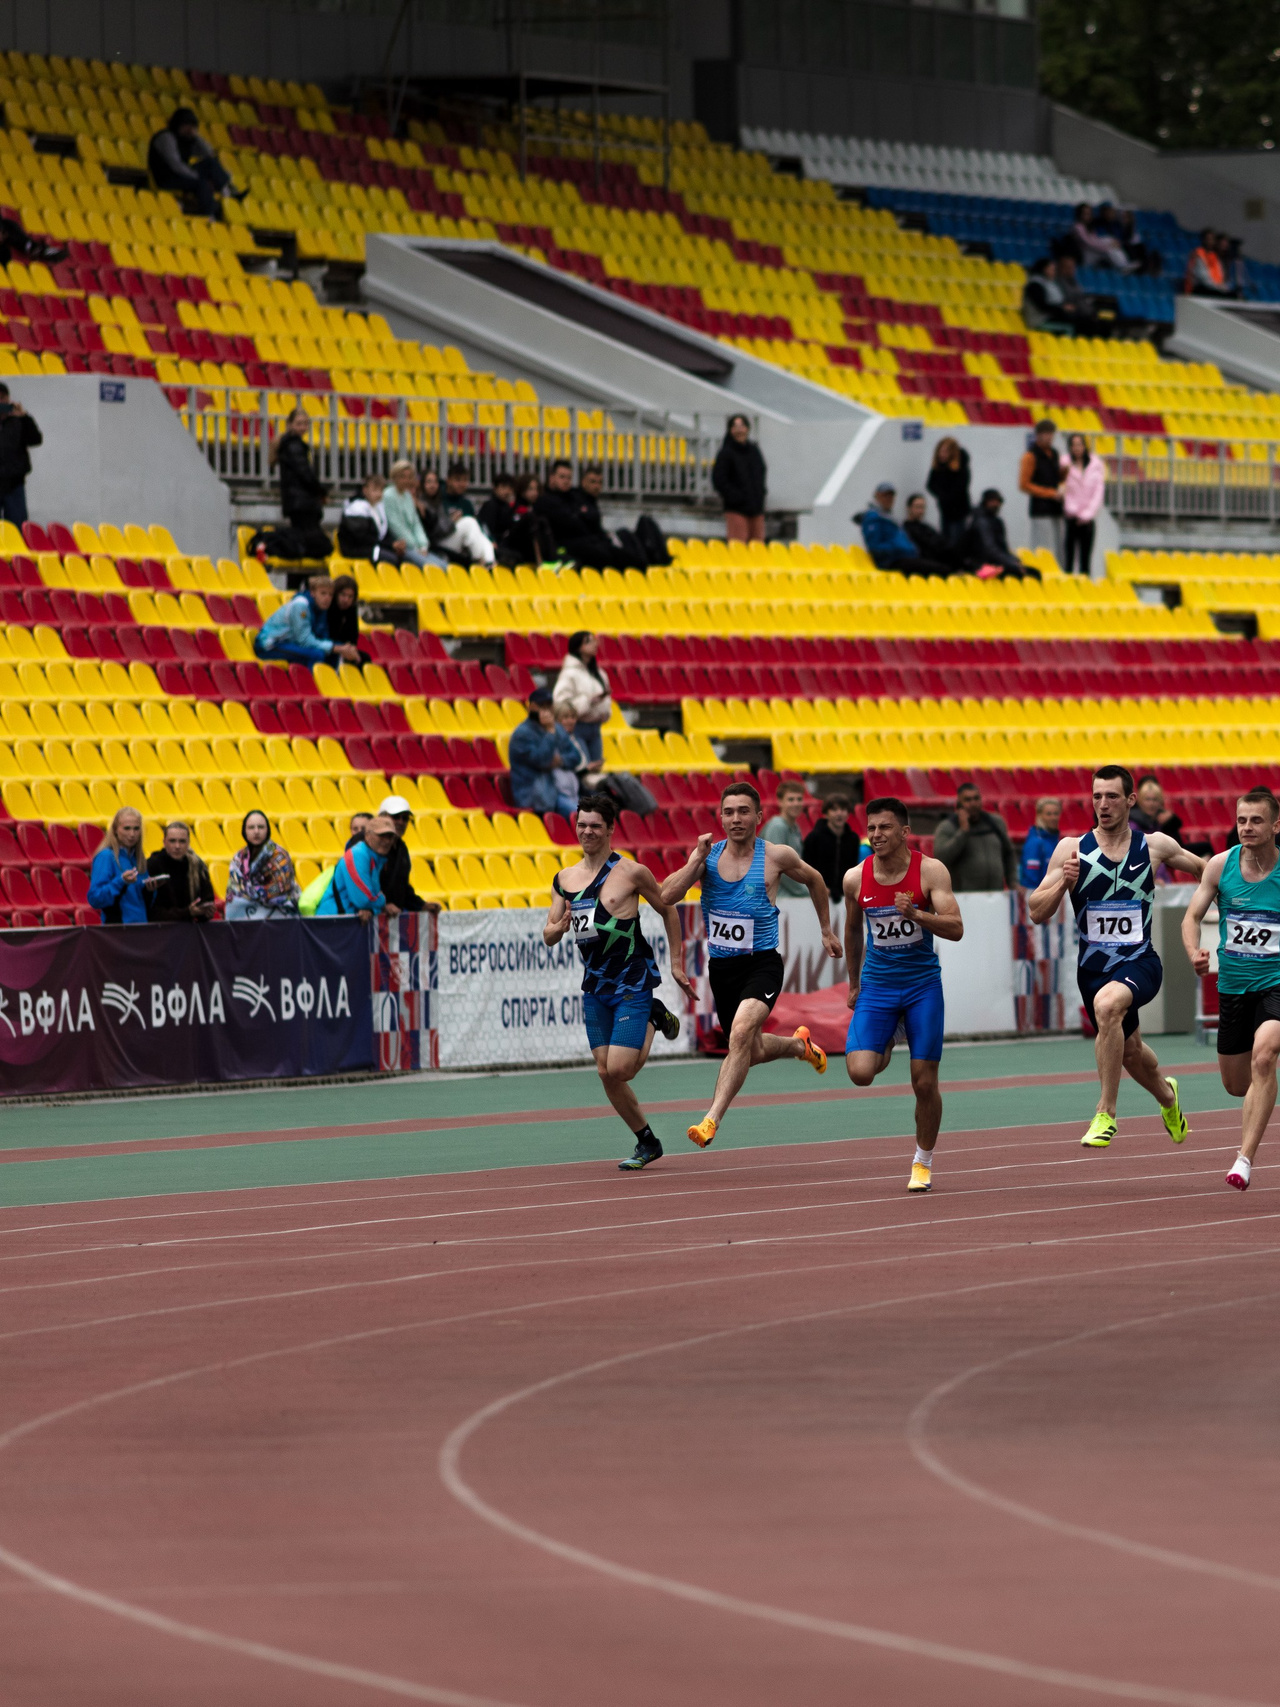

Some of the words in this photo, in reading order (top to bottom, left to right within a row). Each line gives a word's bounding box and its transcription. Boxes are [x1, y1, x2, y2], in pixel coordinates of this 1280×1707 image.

[571, 914, 589, 933] 92
[712, 920, 745, 941] 740
[875, 919, 915, 939] 240
[1096, 916, 1132, 935] 170
[1232, 925, 1272, 946] 249
[450, 933, 575, 975] ВСЕРОССИЙСКАЯ
[151, 981, 226, 1028] ВФЛА
[280, 975, 351, 1020] ВФЛА
[19, 987, 95, 1036] ВФЛА
[501, 998, 557, 1029] СПОРТА
